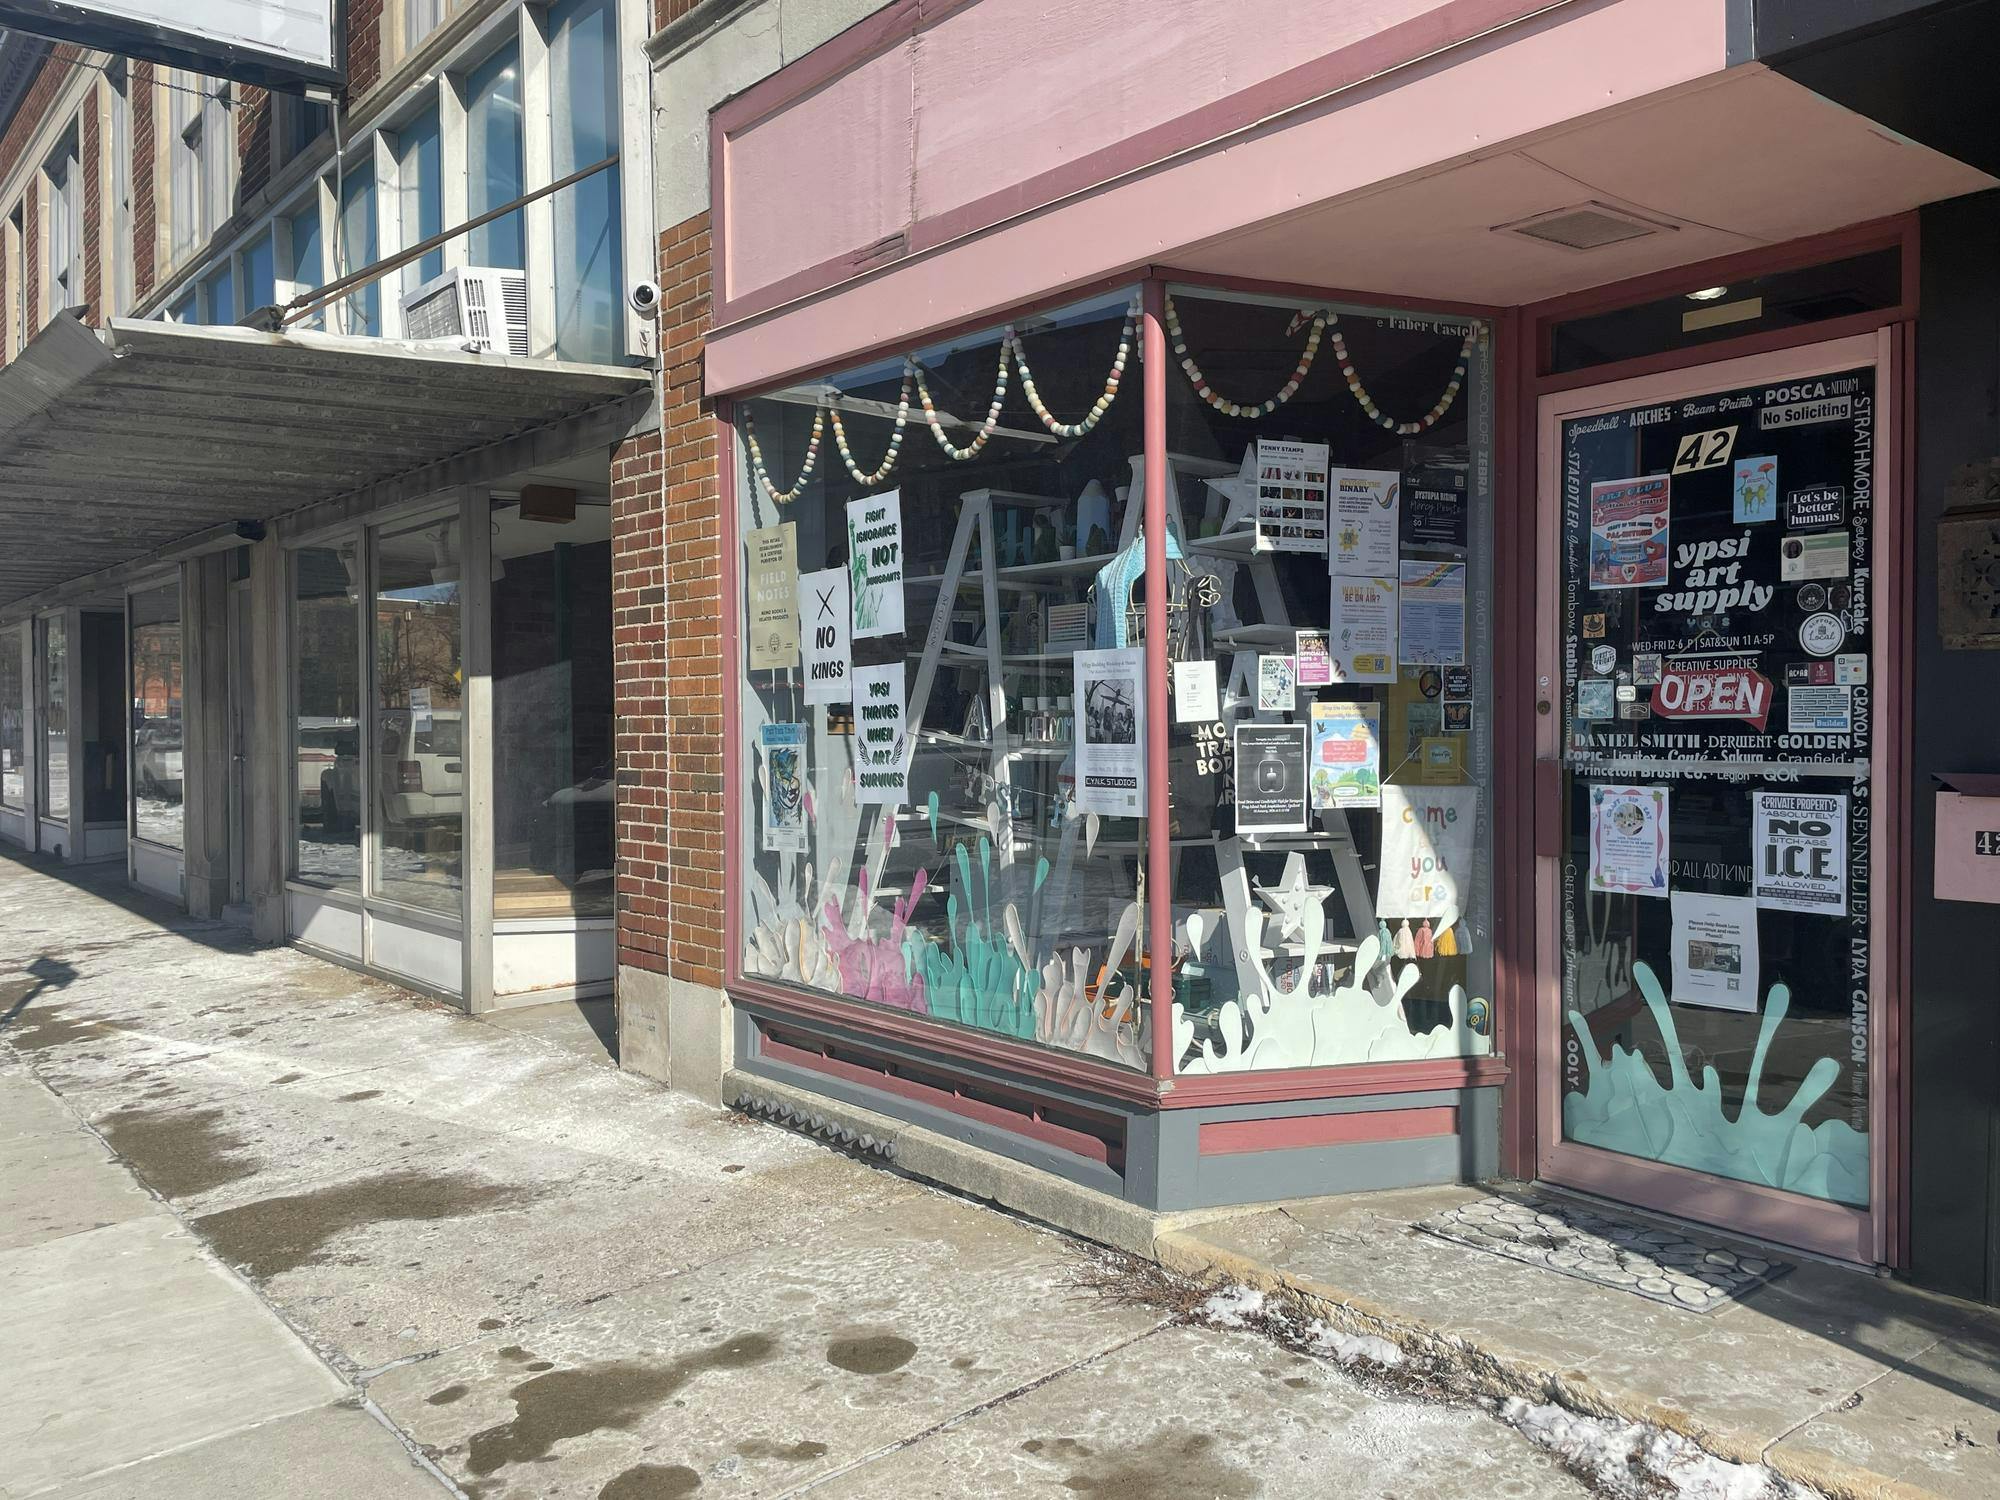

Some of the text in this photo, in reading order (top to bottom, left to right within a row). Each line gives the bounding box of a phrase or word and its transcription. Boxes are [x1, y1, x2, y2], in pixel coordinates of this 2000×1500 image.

[1568, 378, 1859, 444] Speedball ARCHES Beam Paints POSCA NITRAM
[1763, 403, 1849, 425] No Soliciting
[1260, 444, 1304, 454] PENNY STAMPS
[1676, 430, 1730, 468] 42
[1853, 396, 1871, 510] STRATHMORE
[1477, 451, 1488, 496] ZEBRA
[1340, 485, 1369, 493] BINARY
[1566, 450, 1580, 528] STAEDTLER
[1793, 490, 1839, 504] Let's be
[865, 507, 886, 524] FIGHT
[1797, 502, 1834, 514] better
[1791, 512, 1840, 525] humans
[856, 523, 898, 544] IGNORANCE
[872, 542, 898, 568] NOT
[1674, 529, 1752, 569] ypsi
[760, 571, 786, 585] FIELD
[1685, 562, 1741, 588] art
[757, 586, 790, 602] NOTES
[1344, 593, 1380, 603] BE ON AIR?
[1567, 579, 1580, 629] Tombow
[1654, 580, 1774, 616] supply
[1853, 567, 1869, 635] Kuretake
[1475, 590, 1486, 640] EMOTT
[816, 625, 836, 650] NO
[1700, 635, 1740, 648] SAT&SUN
[1809, 630, 1835, 641] Local
[811, 660, 844, 680] KINGS
[1566, 634, 1578, 687] Stabilo
[1669, 660, 1711, 672] CREATIVE
[1713, 657, 1758, 670] SUPPLIES
[869, 681, 890, 697] YPSI
[1660, 674, 1764, 715] OPEN
[861, 703, 900, 721] THRIVES
[1853, 686, 1869, 748] CRAYOLA
[867, 726, 894, 744] WHEN
[1476, 712, 1487, 774] Mitsubishi
[1574, 733, 1850, 750] DANIEL SMITH DERWENT GOLDEN
[871, 749, 892, 766] ART
[1575, 763, 1636, 777] Princeton
[859, 772, 905, 789] SURVIVES
[1106, 778, 1136, 788] STUDIOS
[1765, 796, 1834, 811] PRIVATE PROPERTY
[1402, 805, 1458, 830] come
[1765, 810, 1836, 820] ABSOLUTELY
[1769, 819, 1832, 837] NO
[1770, 837, 1828, 847] BITCH-ASS
[1411, 856, 1448, 880] you
[1682, 861, 1701, 880] ALL
[1765, 844, 1839, 882] I.C.E.
[1852, 805, 1868, 925] SENNELIER
[1411, 883, 1448, 902] are
[1774, 880, 1826, 890] ALLOWED
[1564, 862, 1577, 942] CRETACOLOR
[1851, 938, 1867, 980] LYRA
[1851, 989, 1867, 1063] CANSON
[1566, 1038, 1579, 1088] OOLY
